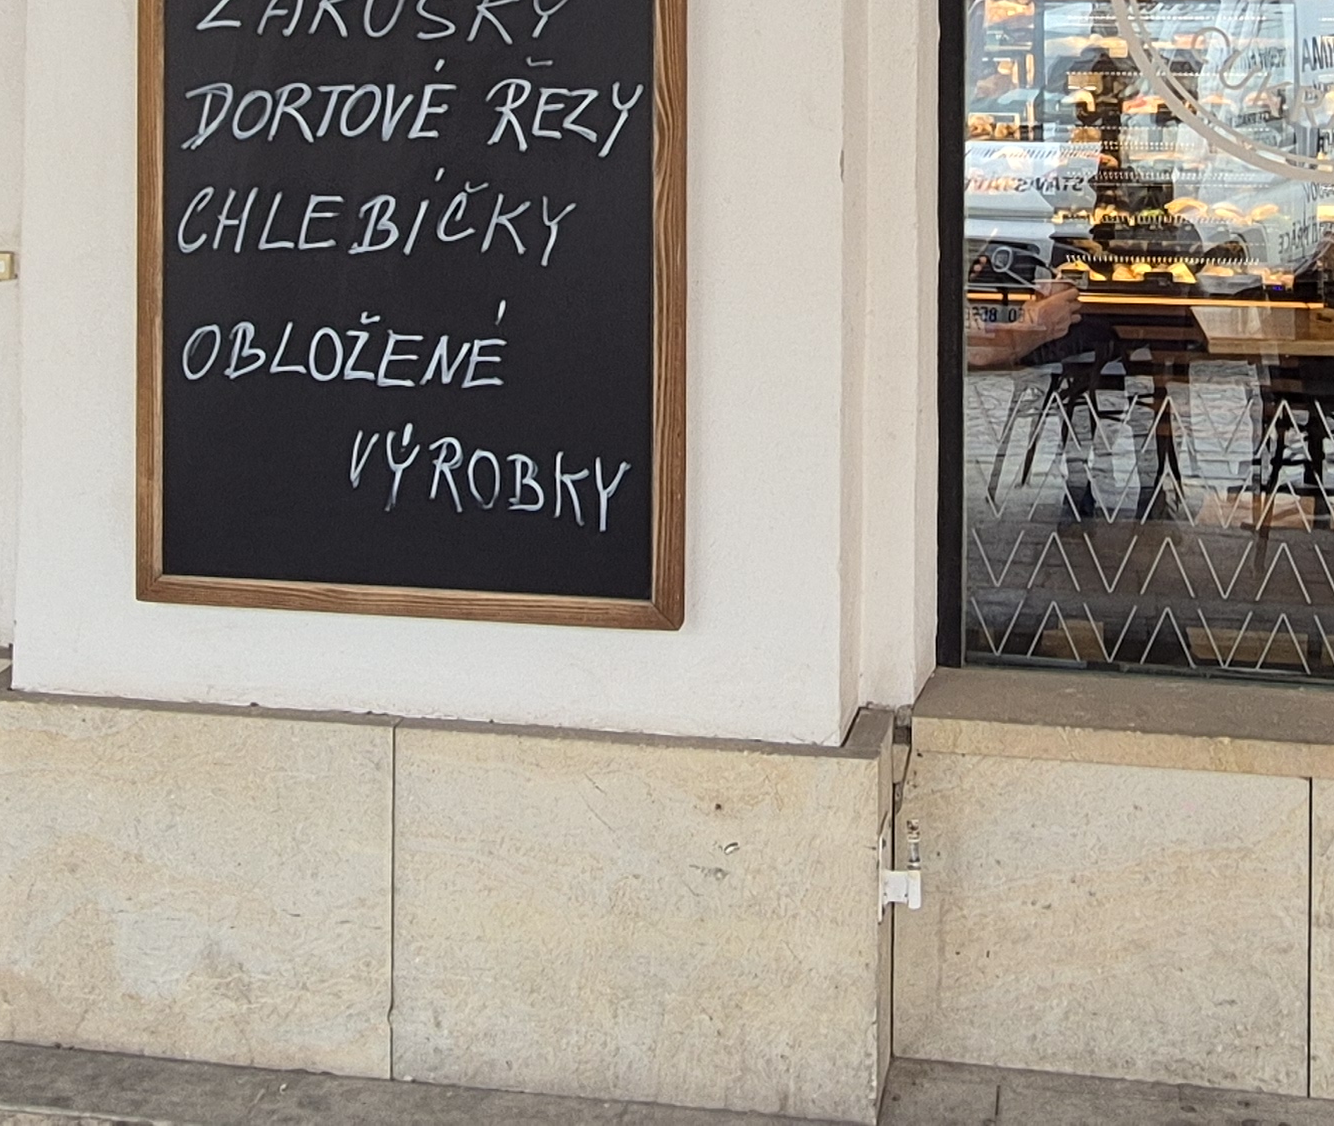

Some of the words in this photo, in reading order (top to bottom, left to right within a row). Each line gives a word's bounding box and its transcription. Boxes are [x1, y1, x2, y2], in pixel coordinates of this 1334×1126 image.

[181, 58, 457, 151] DORTOVÉ
[485, 56, 645, 158] ŘEZY
[177, 166, 577, 267] CHLEBÍČKY
[181, 299, 508, 389] OBLOŽENÉ
[349, 422, 632, 532] VÝROBKY
